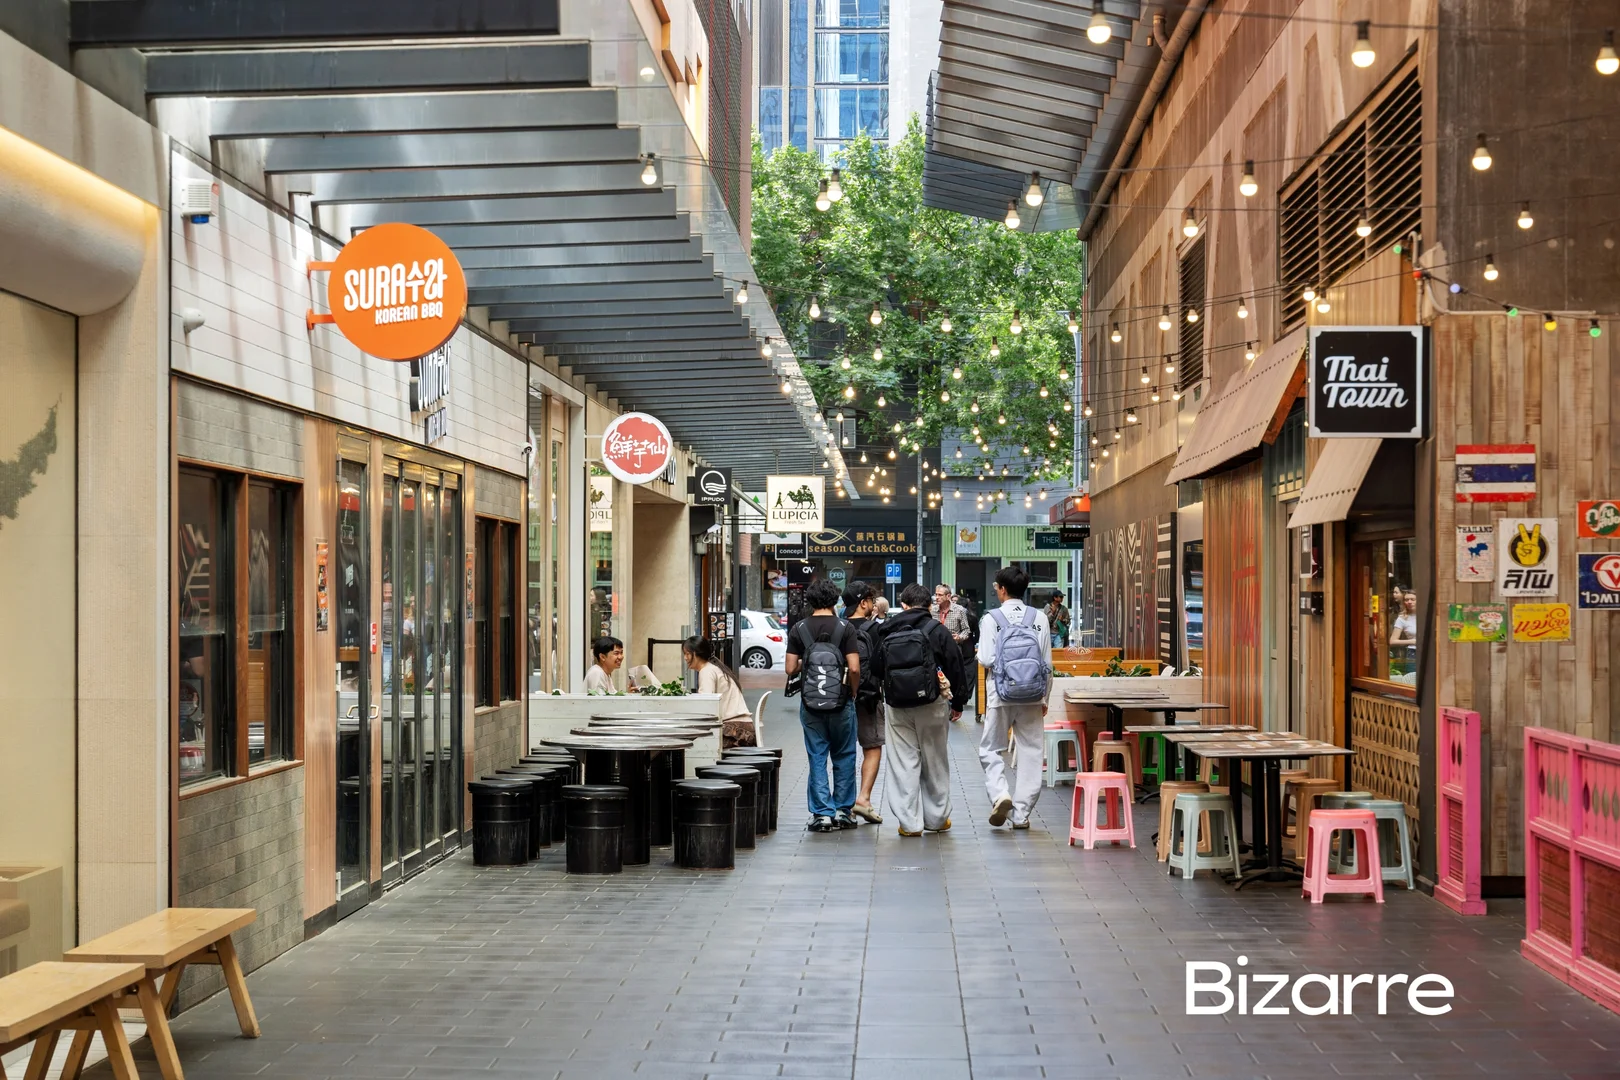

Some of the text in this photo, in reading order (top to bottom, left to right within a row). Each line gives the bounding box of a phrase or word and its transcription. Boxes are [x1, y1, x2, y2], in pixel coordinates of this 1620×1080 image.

[374, 301, 443, 325] KOREAN BBQ
[1322, 355, 1389, 382] Thai
[1322, 382, 1409, 408] Town
[772, 511, 819, 520] LUPICIA
[848, 544, 917, 553] Catch&Cook
[802, 566, 815, 574] QV
[829, 571, 846, 579] OPEN
[887, 566, 892, 576] P
[895, 566, 900, 576] P
